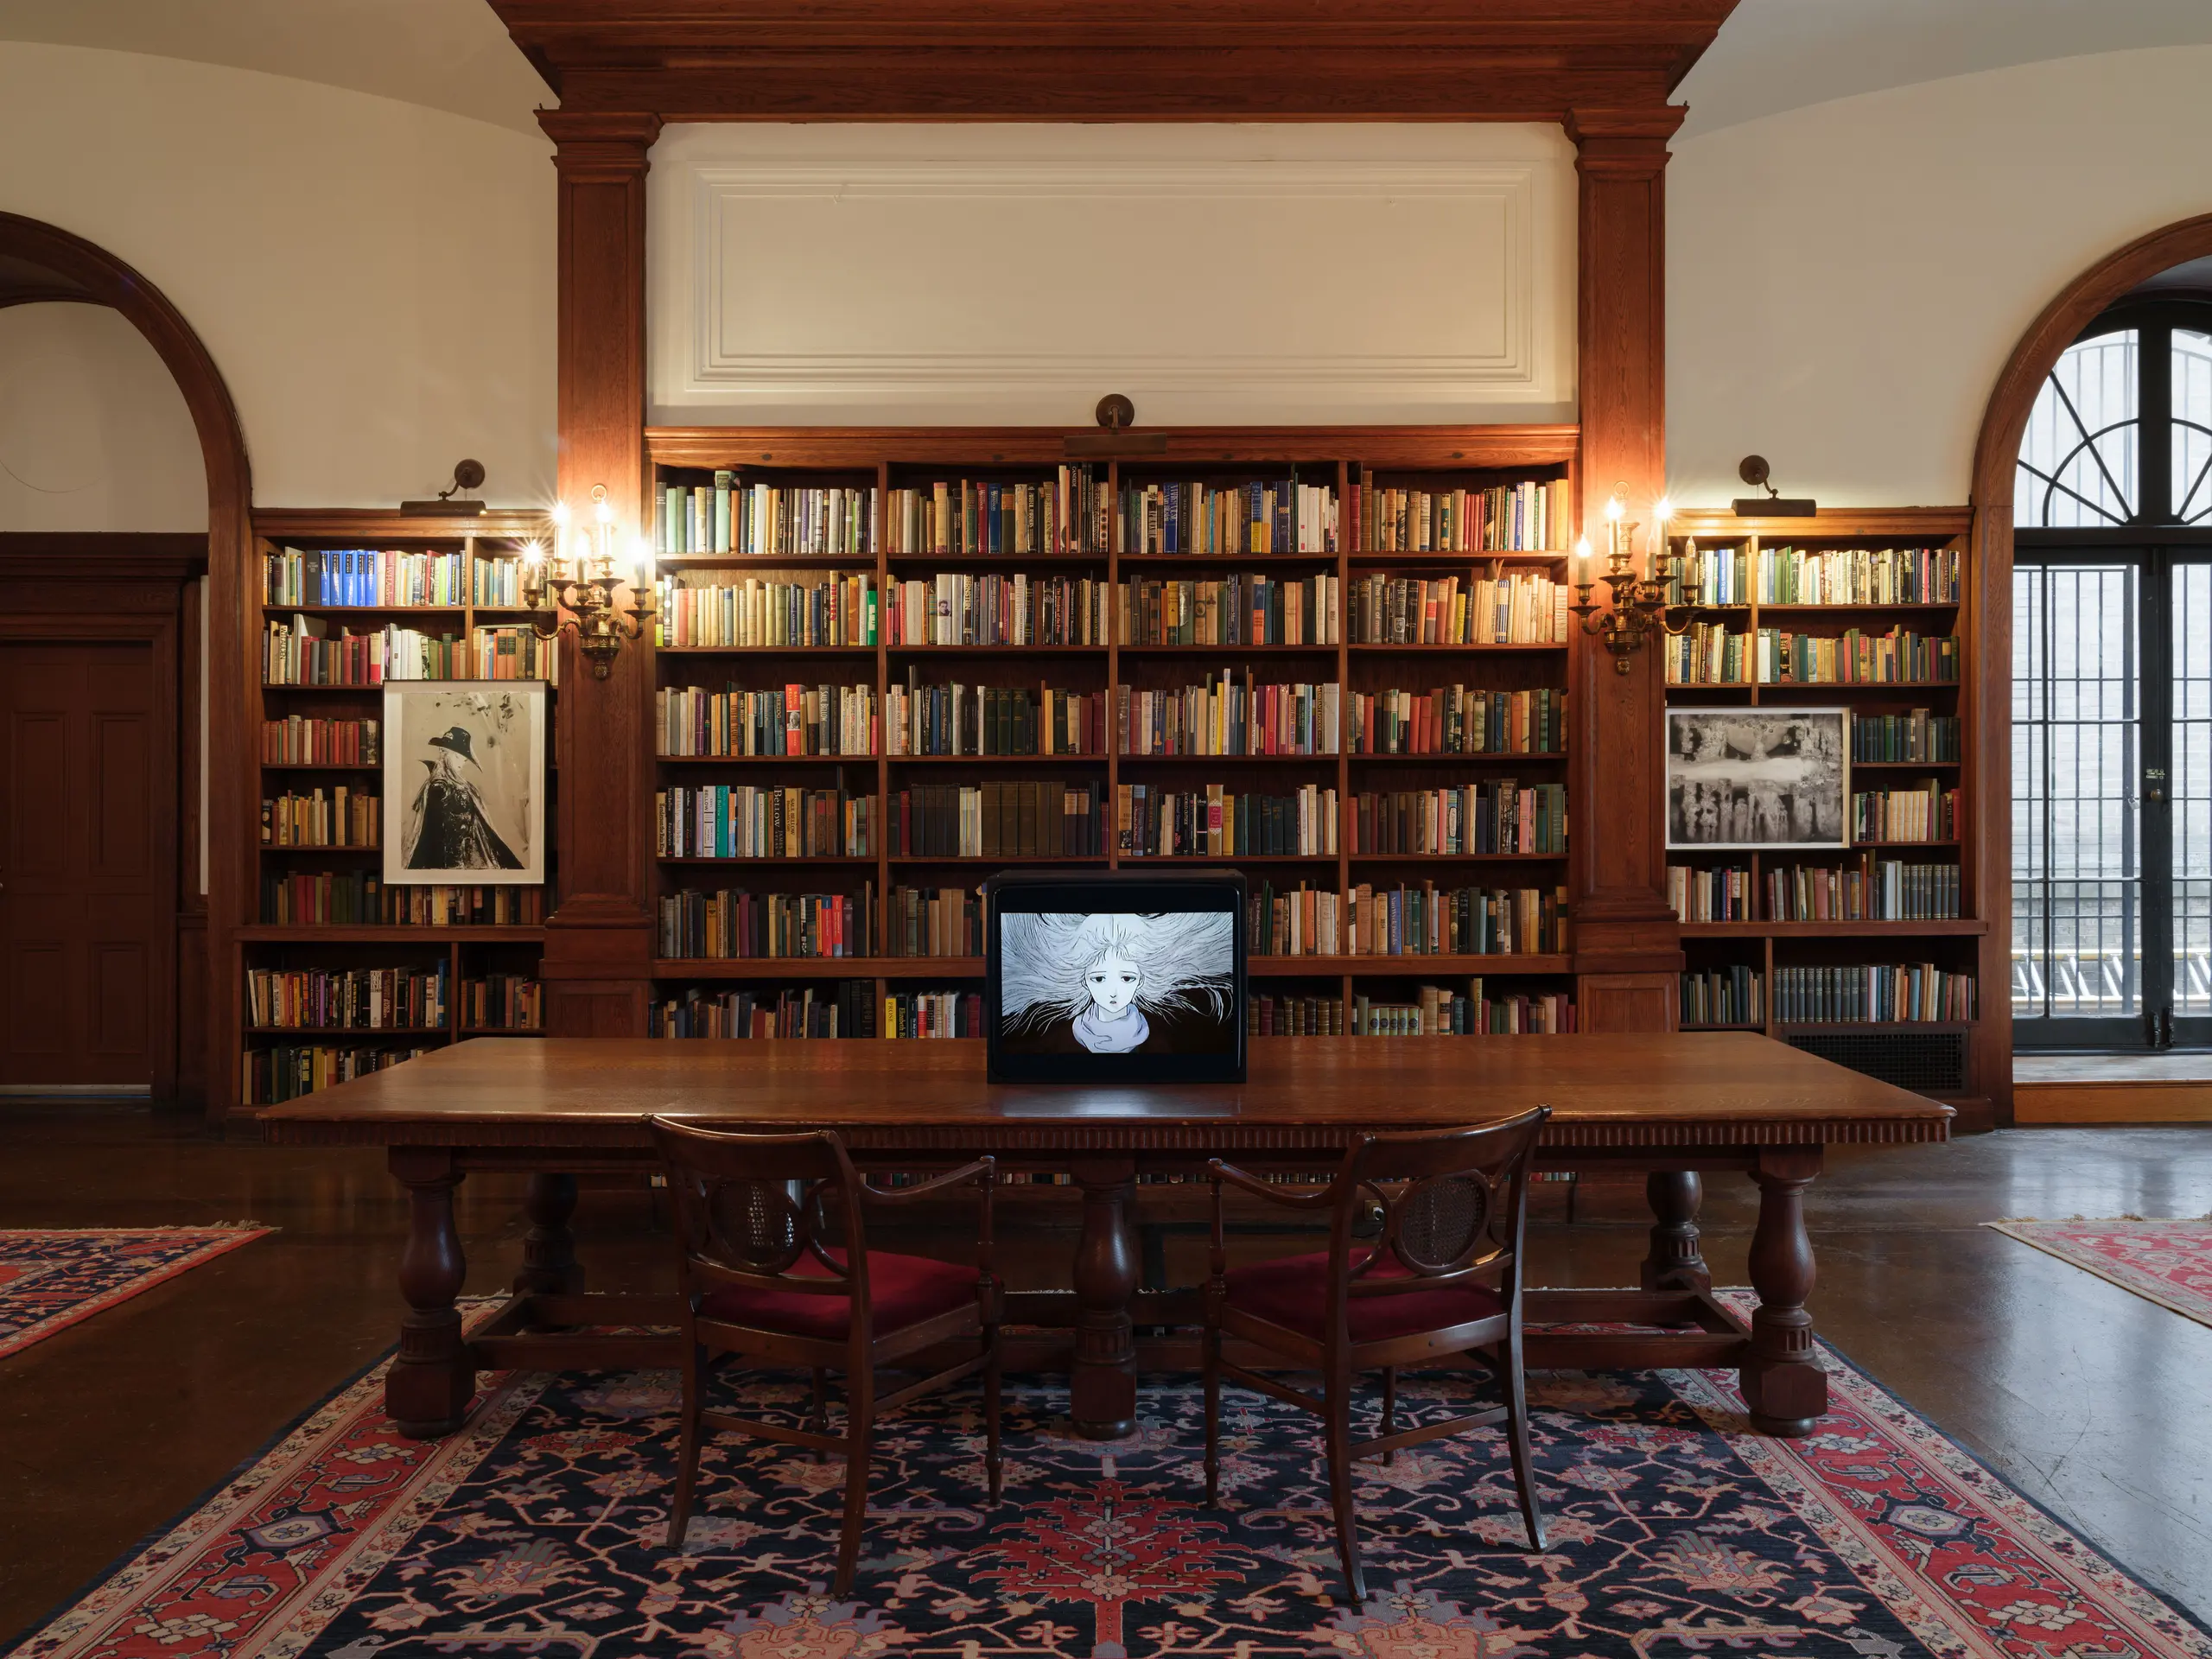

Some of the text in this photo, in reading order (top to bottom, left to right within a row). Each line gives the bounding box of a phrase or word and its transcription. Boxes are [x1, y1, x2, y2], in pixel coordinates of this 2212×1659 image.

[1375, 584, 1383, 596] the
[1375, 597, 1383, 610] fate
[1375, 620, 1383, 635] men
[820, 690, 830, 722] SAUL BELLOW
